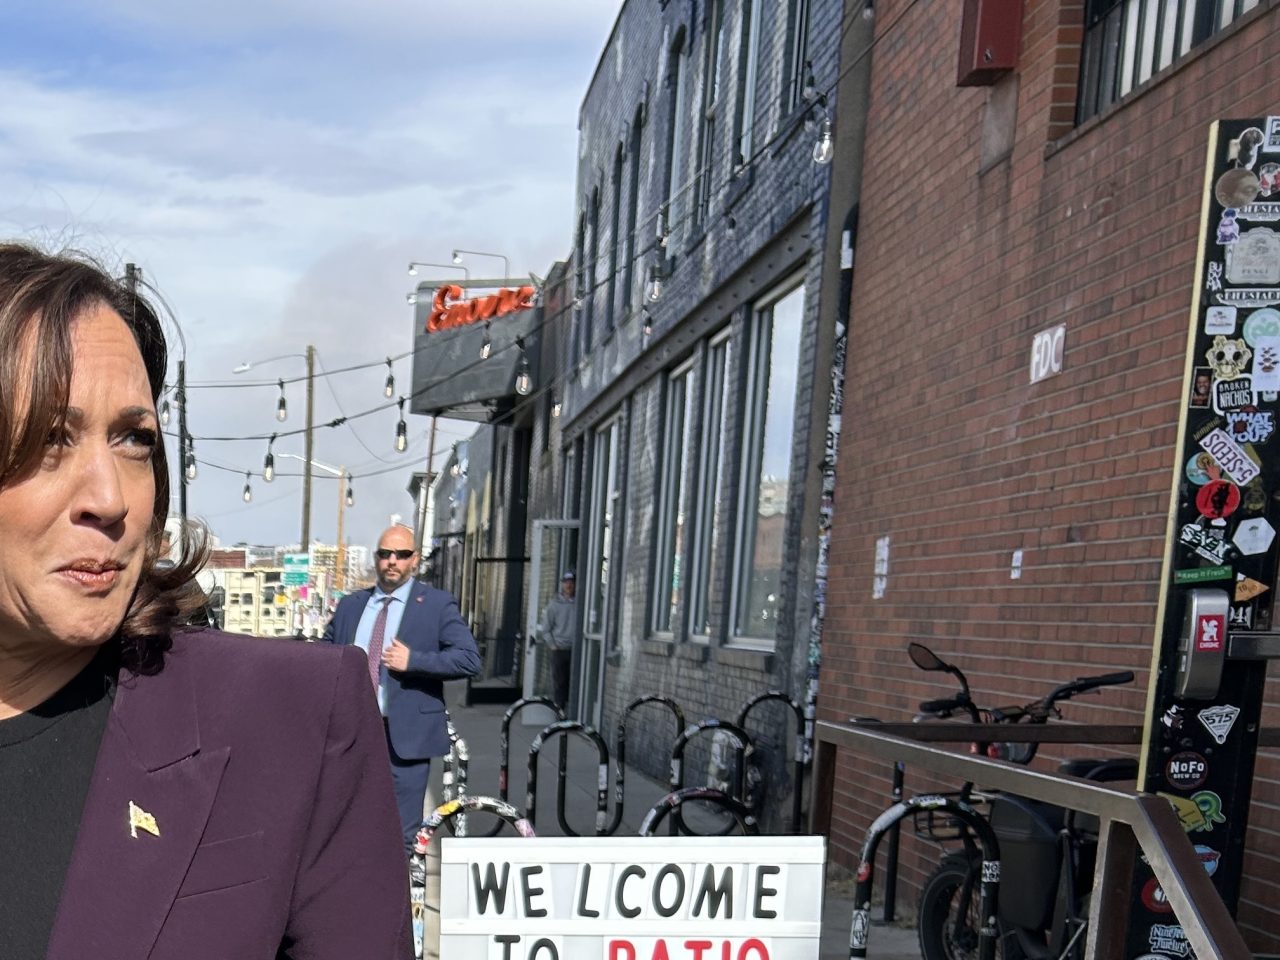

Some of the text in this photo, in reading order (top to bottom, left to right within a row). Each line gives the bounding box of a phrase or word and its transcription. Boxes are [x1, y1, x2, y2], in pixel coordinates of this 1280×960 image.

[1030, 326, 1065, 381] FDC
[1220, 390, 1251, 408] NACHOS
[1226, 412, 1272, 424] WHAT
[1205, 713, 1233, 725] 575
[1170, 760, 1205, 773] NoFo
